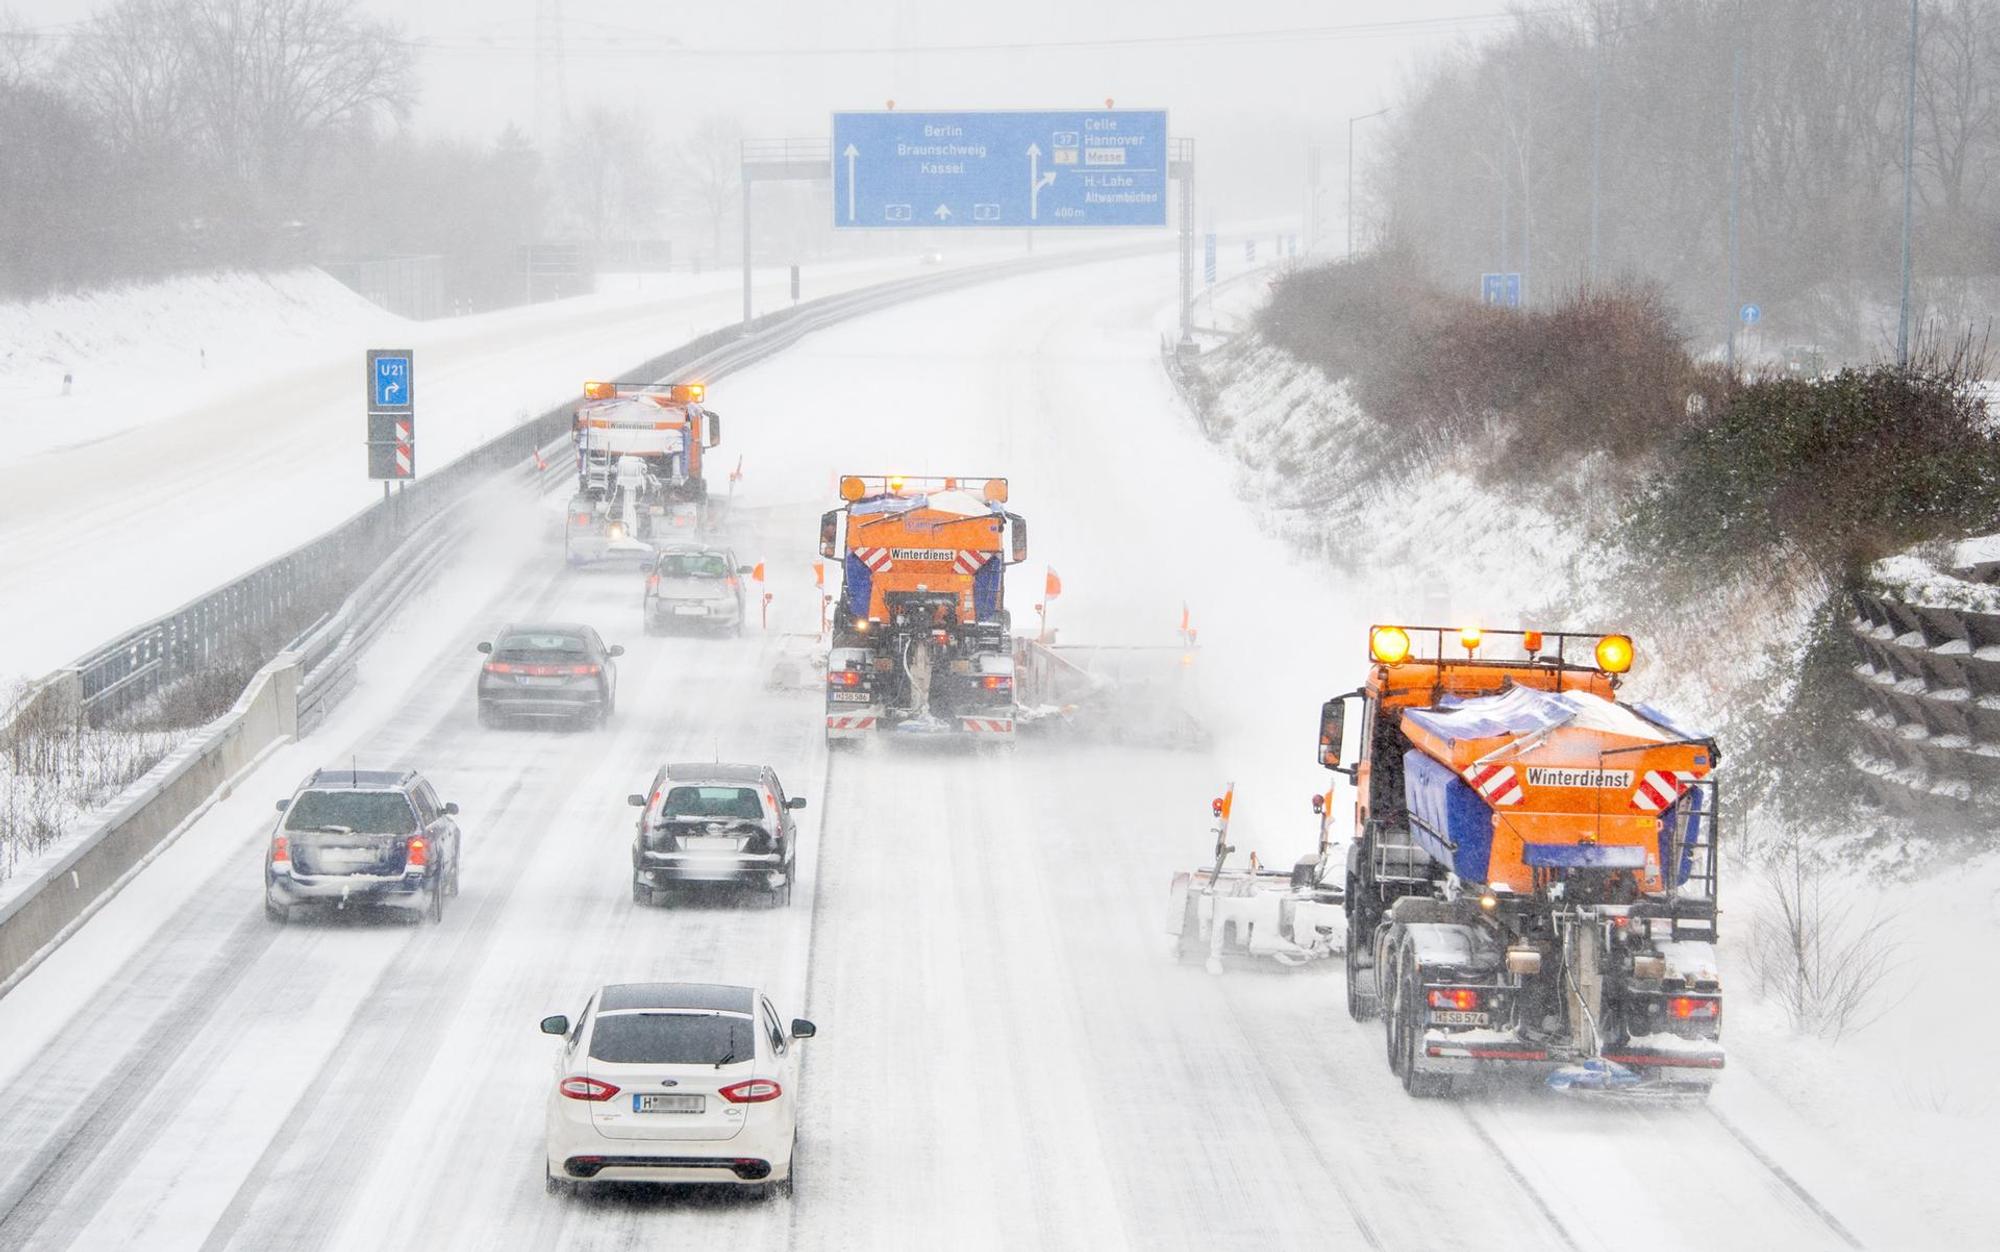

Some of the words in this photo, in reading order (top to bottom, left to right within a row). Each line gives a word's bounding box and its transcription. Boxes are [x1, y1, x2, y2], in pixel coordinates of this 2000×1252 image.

[1084, 119, 1117, 130] Celle
[924, 125, 963, 137] Berlin
[1084, 134, 1145, 146] Hannover
[896, 143, 987, 158] Braunschweig
[1087, 151, 1122, 162] Messe
[921, 161, 964, 174] Kassel
[610, 422, 654, 431] Winterdienst
[891, 549, 954, 560] Winterdienst
[1529, 768, 1629, 787] Winterdienst
